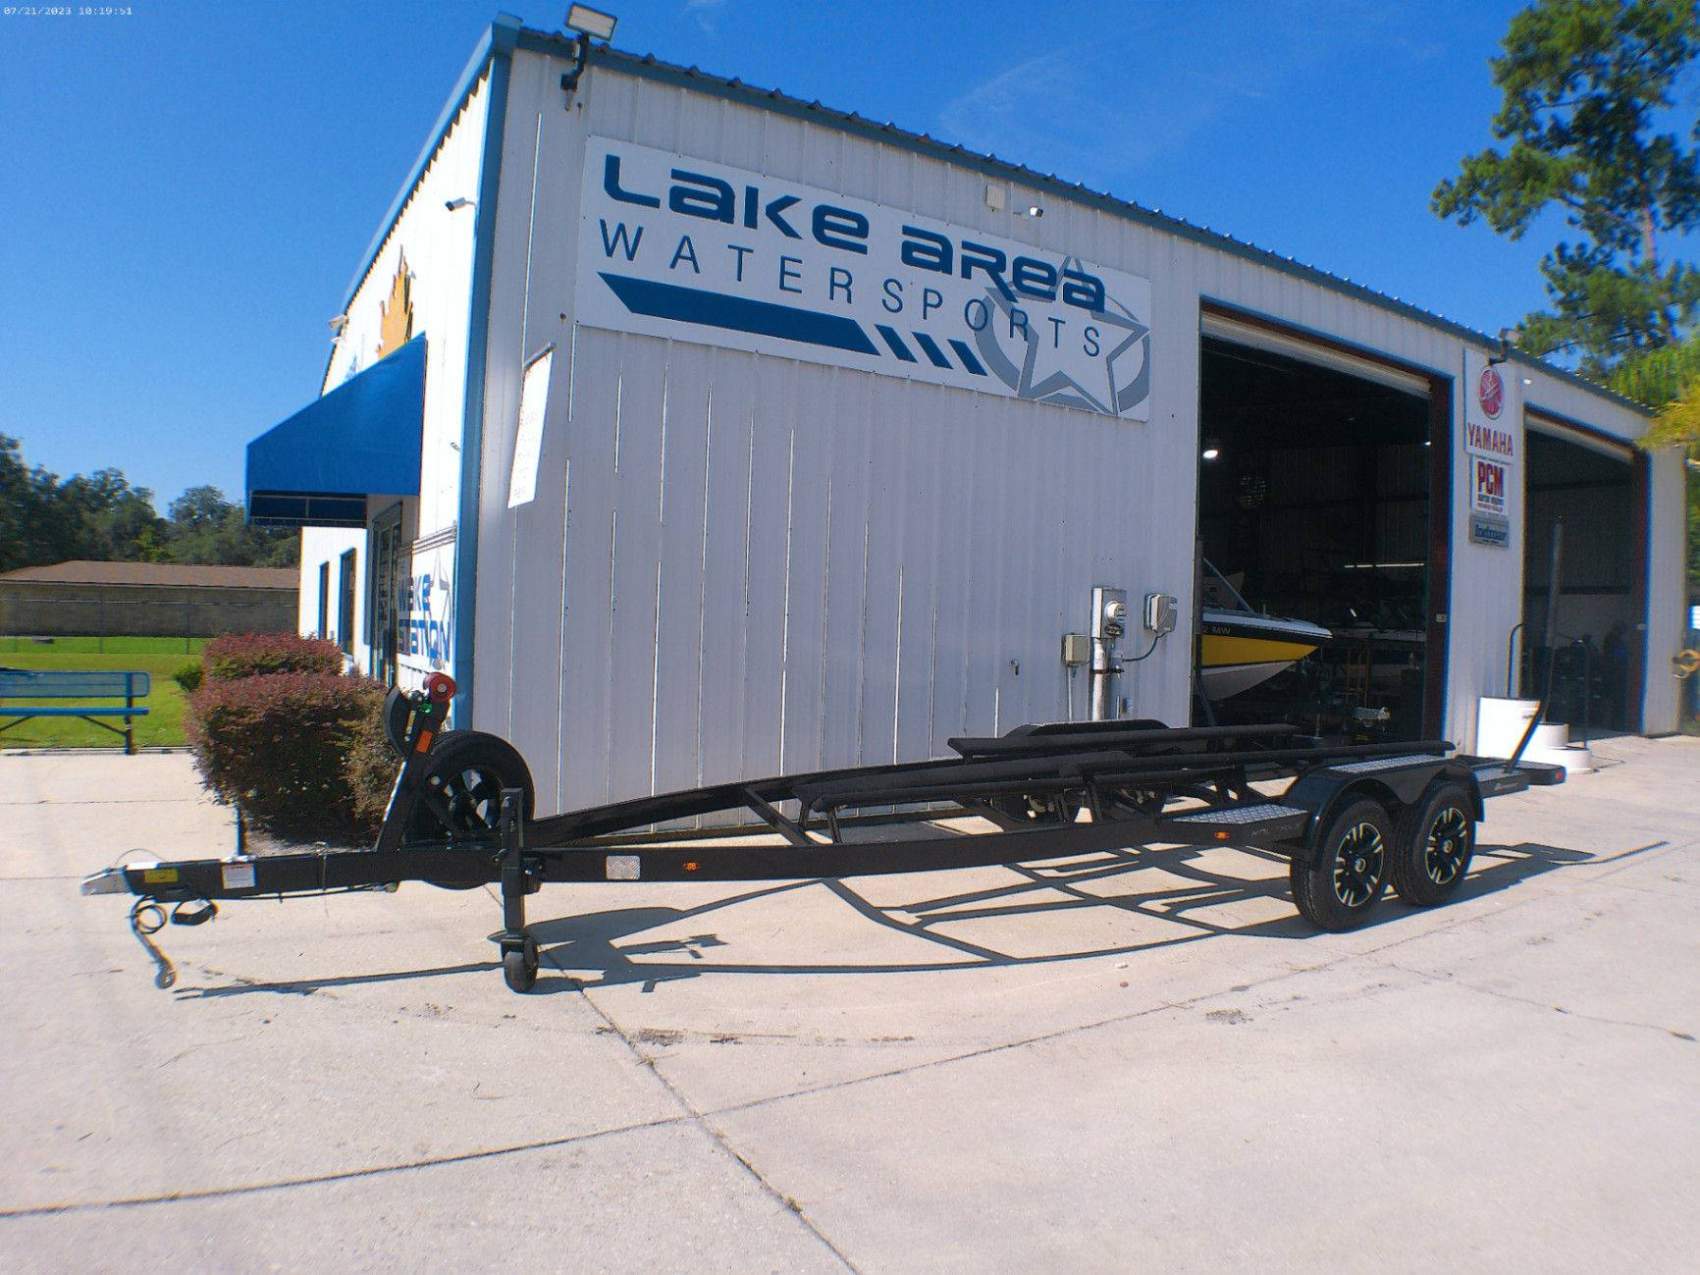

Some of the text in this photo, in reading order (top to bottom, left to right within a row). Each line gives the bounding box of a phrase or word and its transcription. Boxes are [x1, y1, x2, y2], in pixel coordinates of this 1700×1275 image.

[600, 219, 1100, 357] WATERSPORTS
[1468, 423, 1513, 456] YAMAHA
[1477, 461, 1504, 498] PCM
